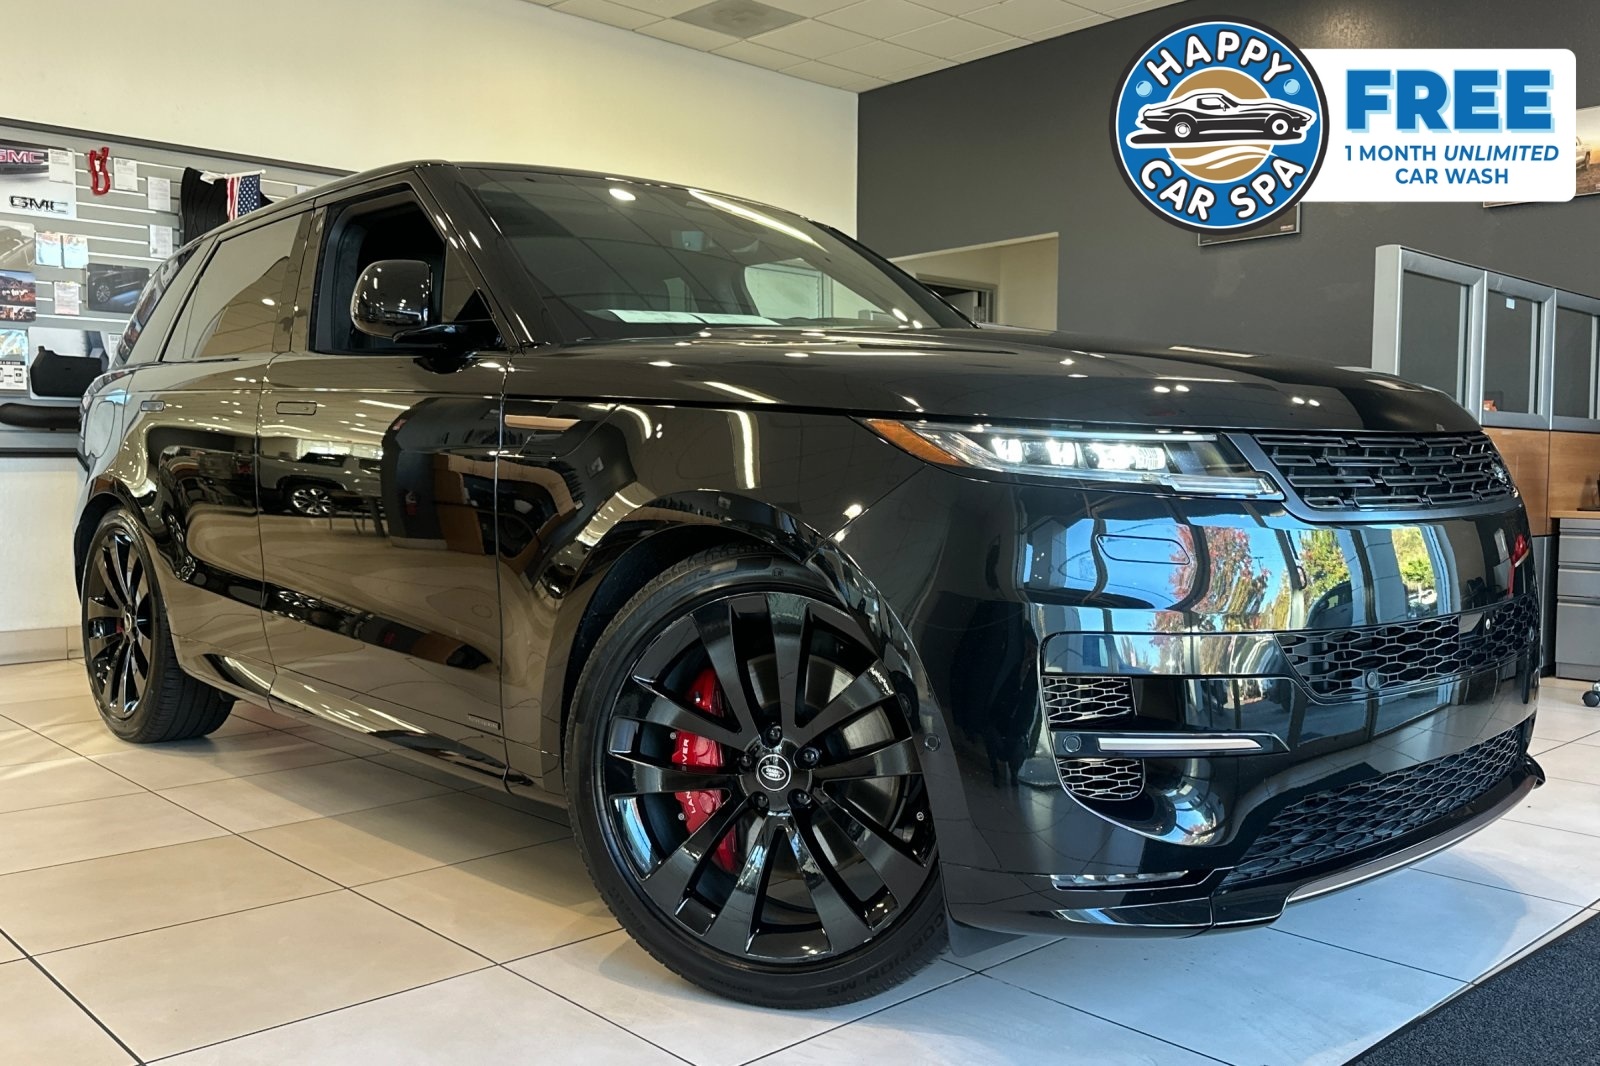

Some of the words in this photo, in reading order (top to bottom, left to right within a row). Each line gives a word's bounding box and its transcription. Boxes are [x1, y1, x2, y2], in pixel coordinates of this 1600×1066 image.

[9, 195, 69, 215] GMC
[685, 791, 696, 814] LAN
[867, 911, 945, 981] CORPION
